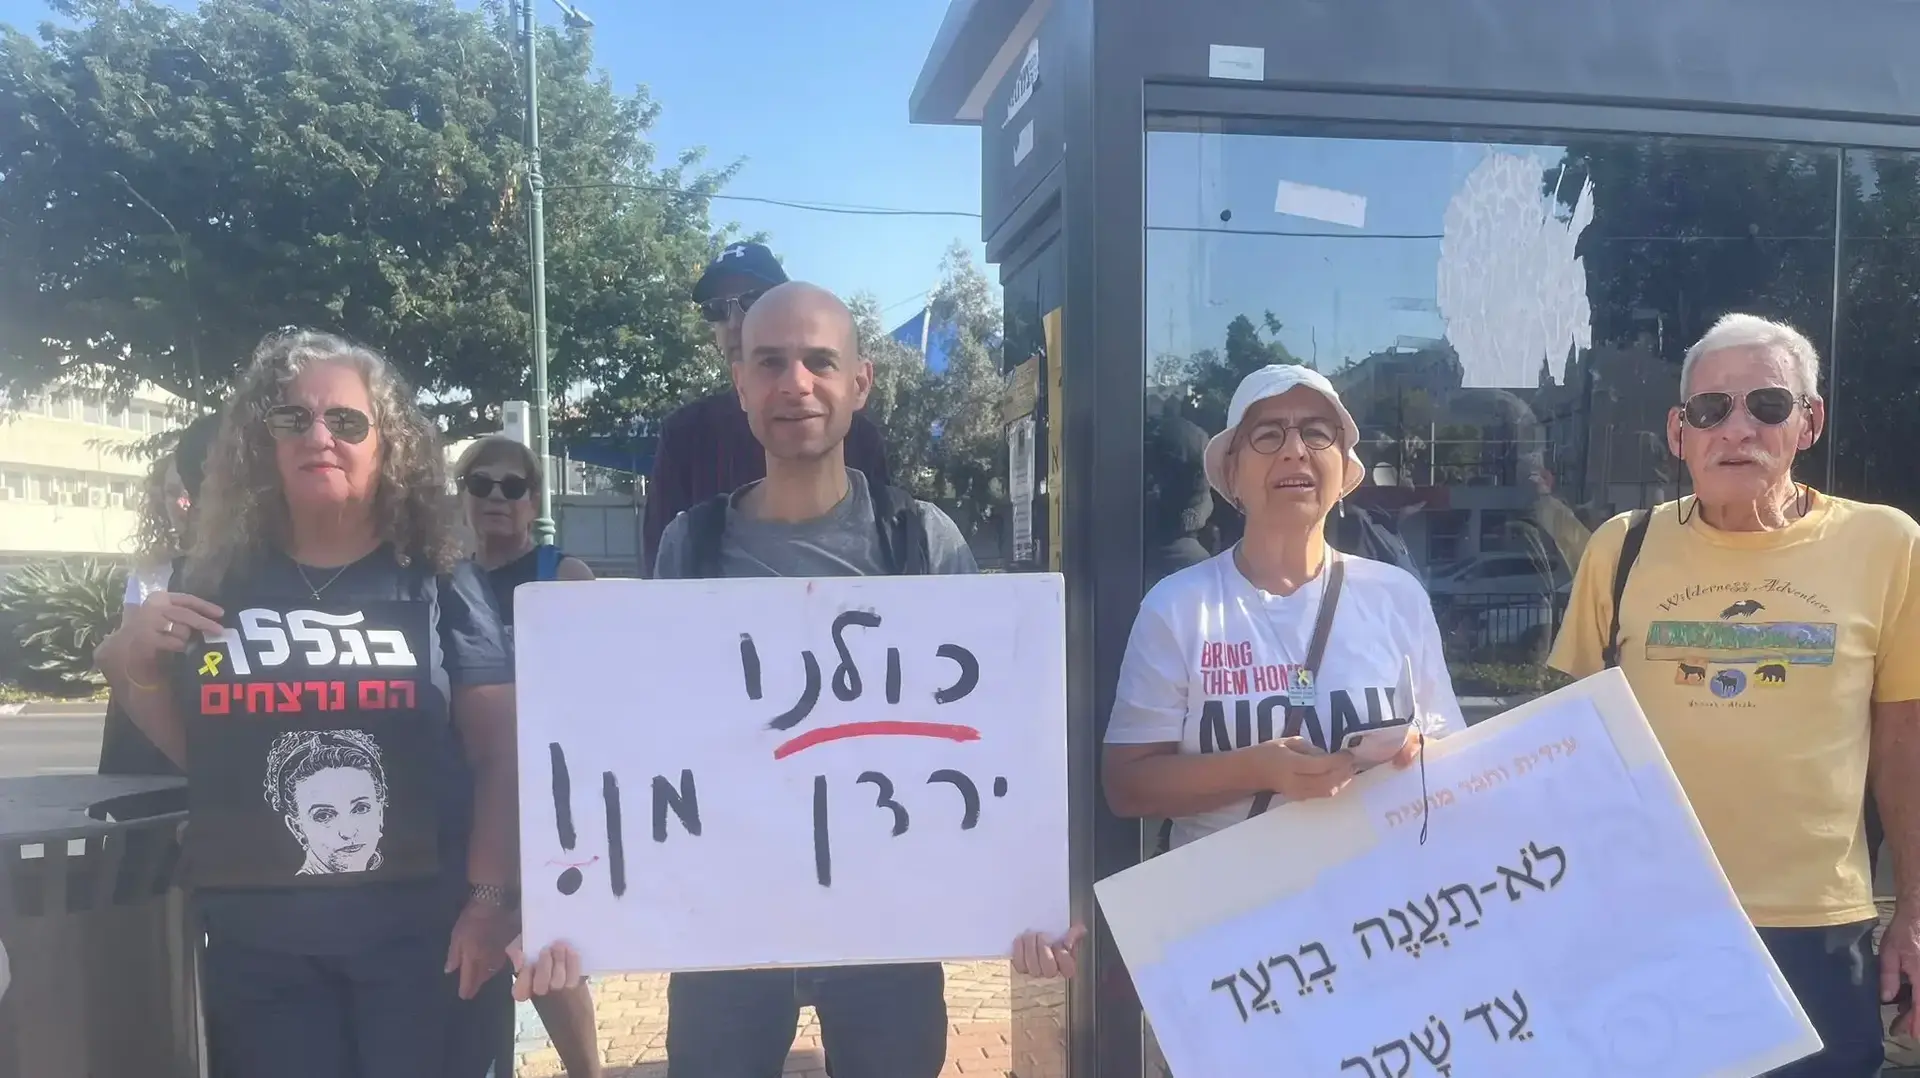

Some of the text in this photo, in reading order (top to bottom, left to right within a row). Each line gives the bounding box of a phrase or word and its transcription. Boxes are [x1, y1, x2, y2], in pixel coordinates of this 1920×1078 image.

[1753, 578, 1831, 613] Adventure
[203, 608, 417, 675] בגללך
[1201, 641, 1253, 669] BRING
[739, 610, 980, 731] כולנו
[1200, 664, 1305, 695] THEM HOM
[201, 680, 416, 714] הם נרצחים
[813, 769, 1008, 887] ירדן
